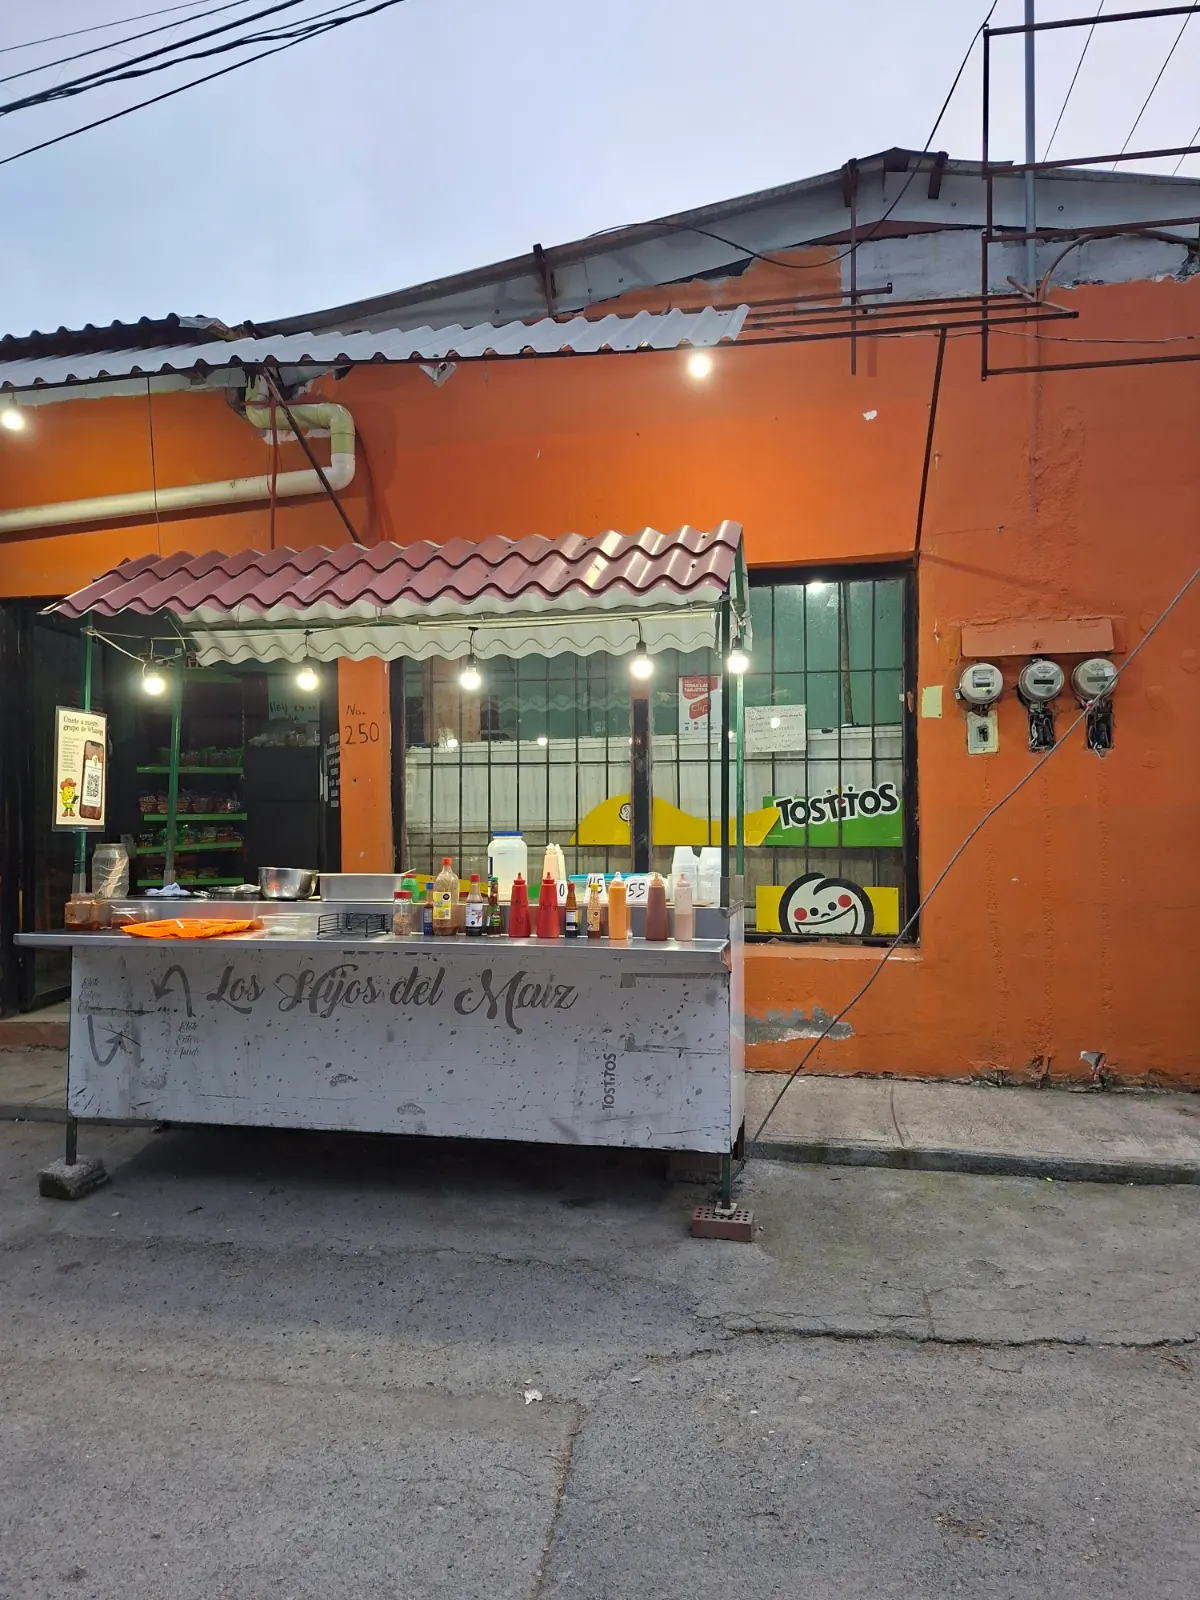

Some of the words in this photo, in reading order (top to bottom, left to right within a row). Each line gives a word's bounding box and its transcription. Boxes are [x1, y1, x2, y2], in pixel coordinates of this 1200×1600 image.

[346, 704, 366, 716] No.
[344, 722, 379, 744] 250
[206, 964, 265, 1015] Los
[273, 963, 382, 1018] Hijos
[389, 966, 445, 1006] del
